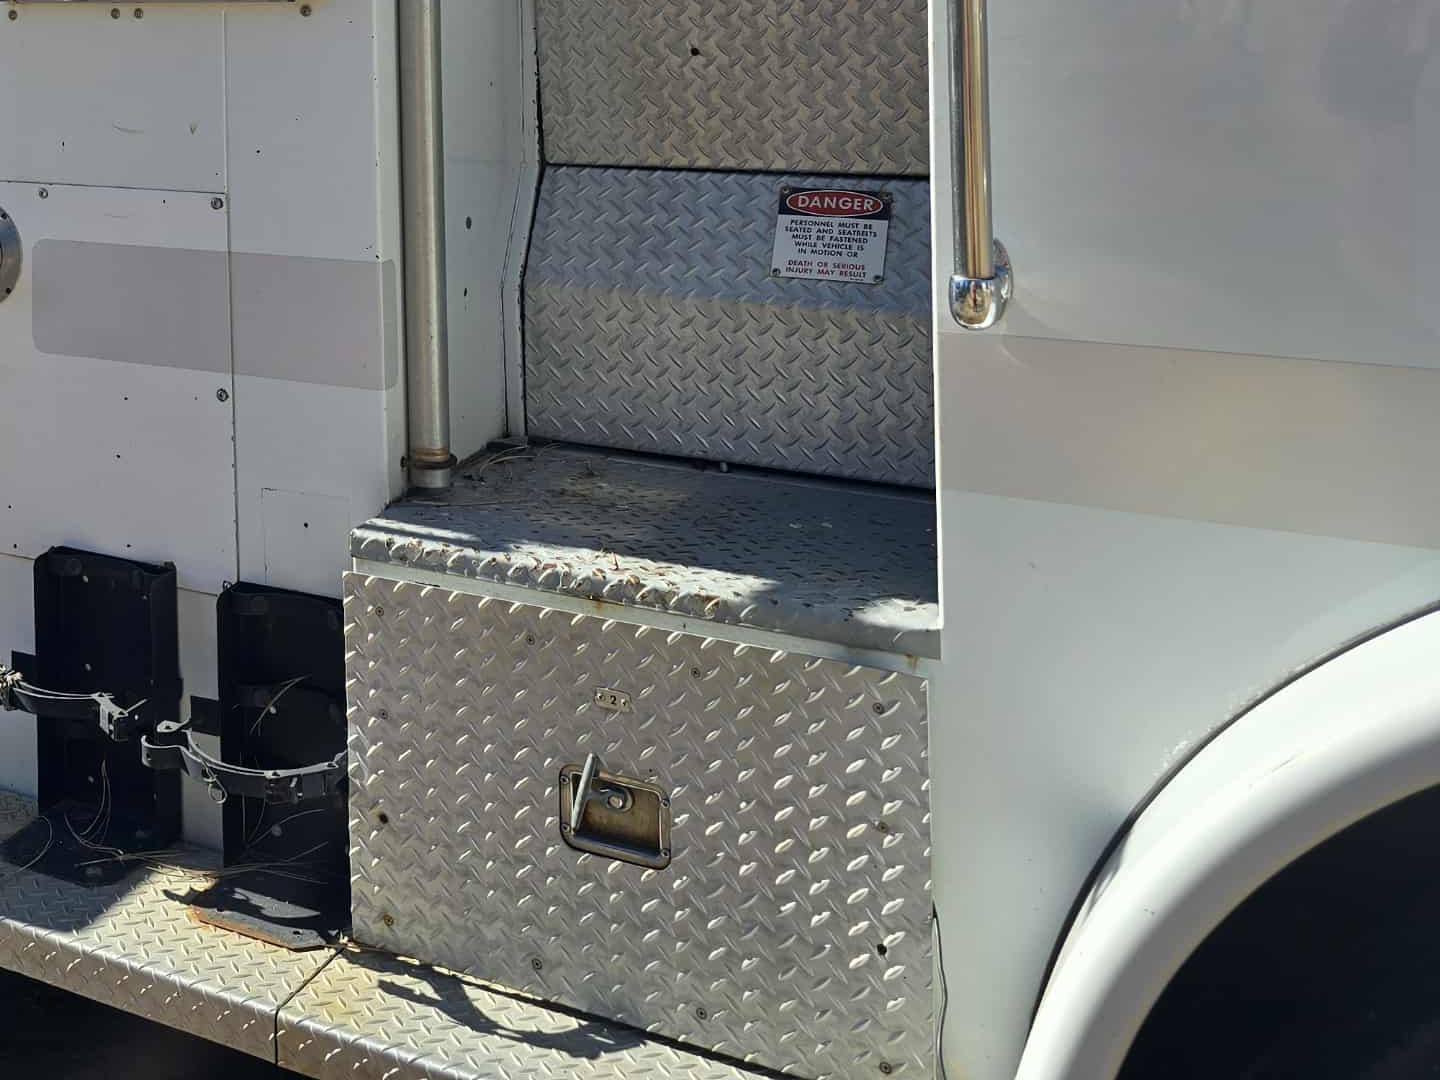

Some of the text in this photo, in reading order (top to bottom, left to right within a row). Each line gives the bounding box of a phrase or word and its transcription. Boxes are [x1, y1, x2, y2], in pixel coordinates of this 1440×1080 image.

[797, 195, 874, 211] DANGER
[790, 219, 833, 228] PERSONNEL
[838, 230, 877, 238] SEATBELTS
[829, 236, 869, 244] FASTENED
[811, 249, 843, 257] MOTION
[832, 262, 865, 270] SERIOUS
[840, 270, 867, 278] RESULT
[610, 695, 617, 706] 2
